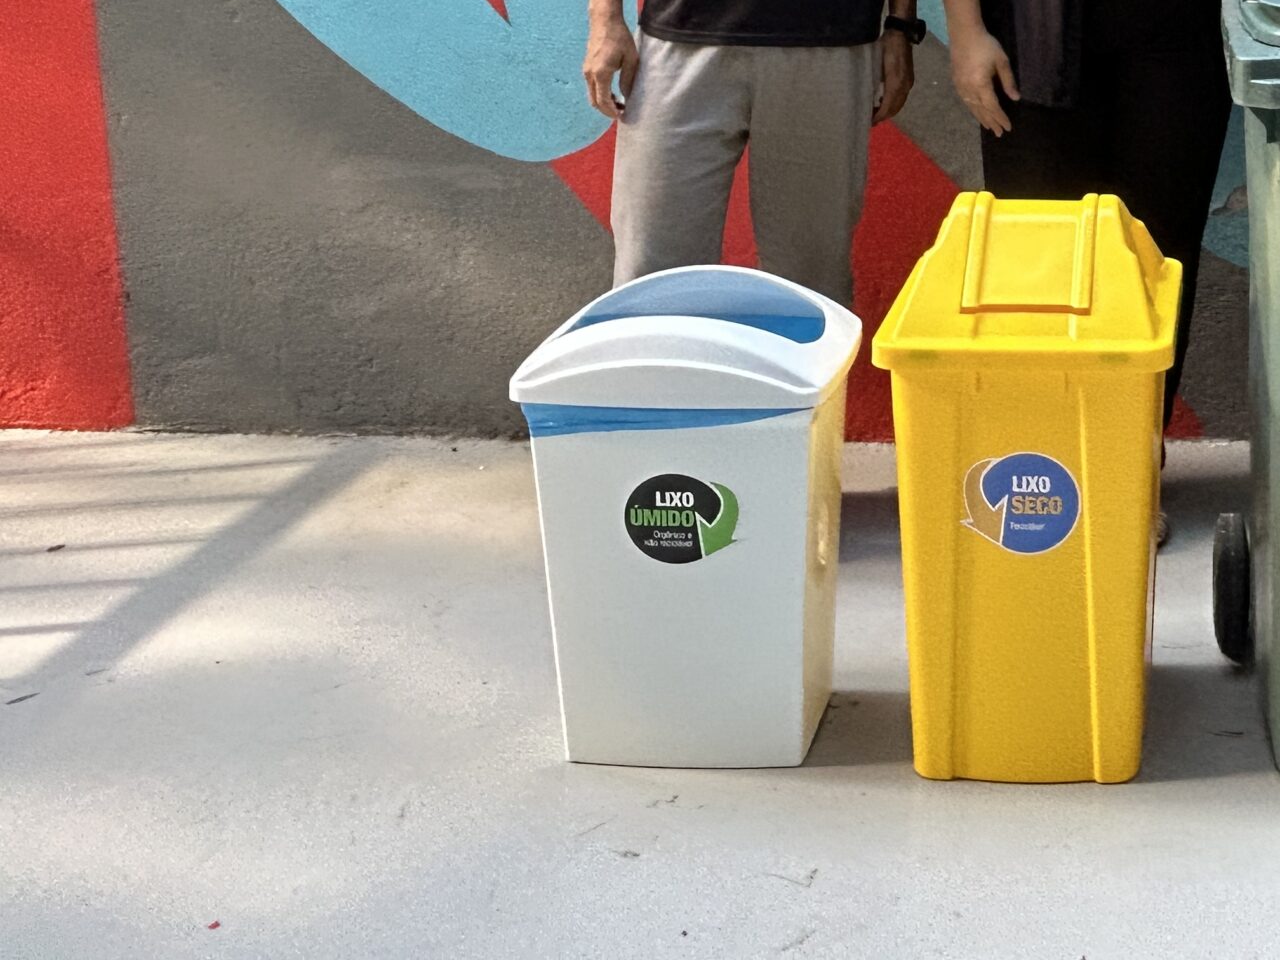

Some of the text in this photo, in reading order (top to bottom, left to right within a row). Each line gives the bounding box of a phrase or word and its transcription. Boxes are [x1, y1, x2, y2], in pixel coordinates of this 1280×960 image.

[1012, 475, 1051, 493] LIXO
[655, 490, 695, 508] LIXO
[1010, 495, 1063, 515] SECO
[630, 504, 695, 527] ÚMIDO
